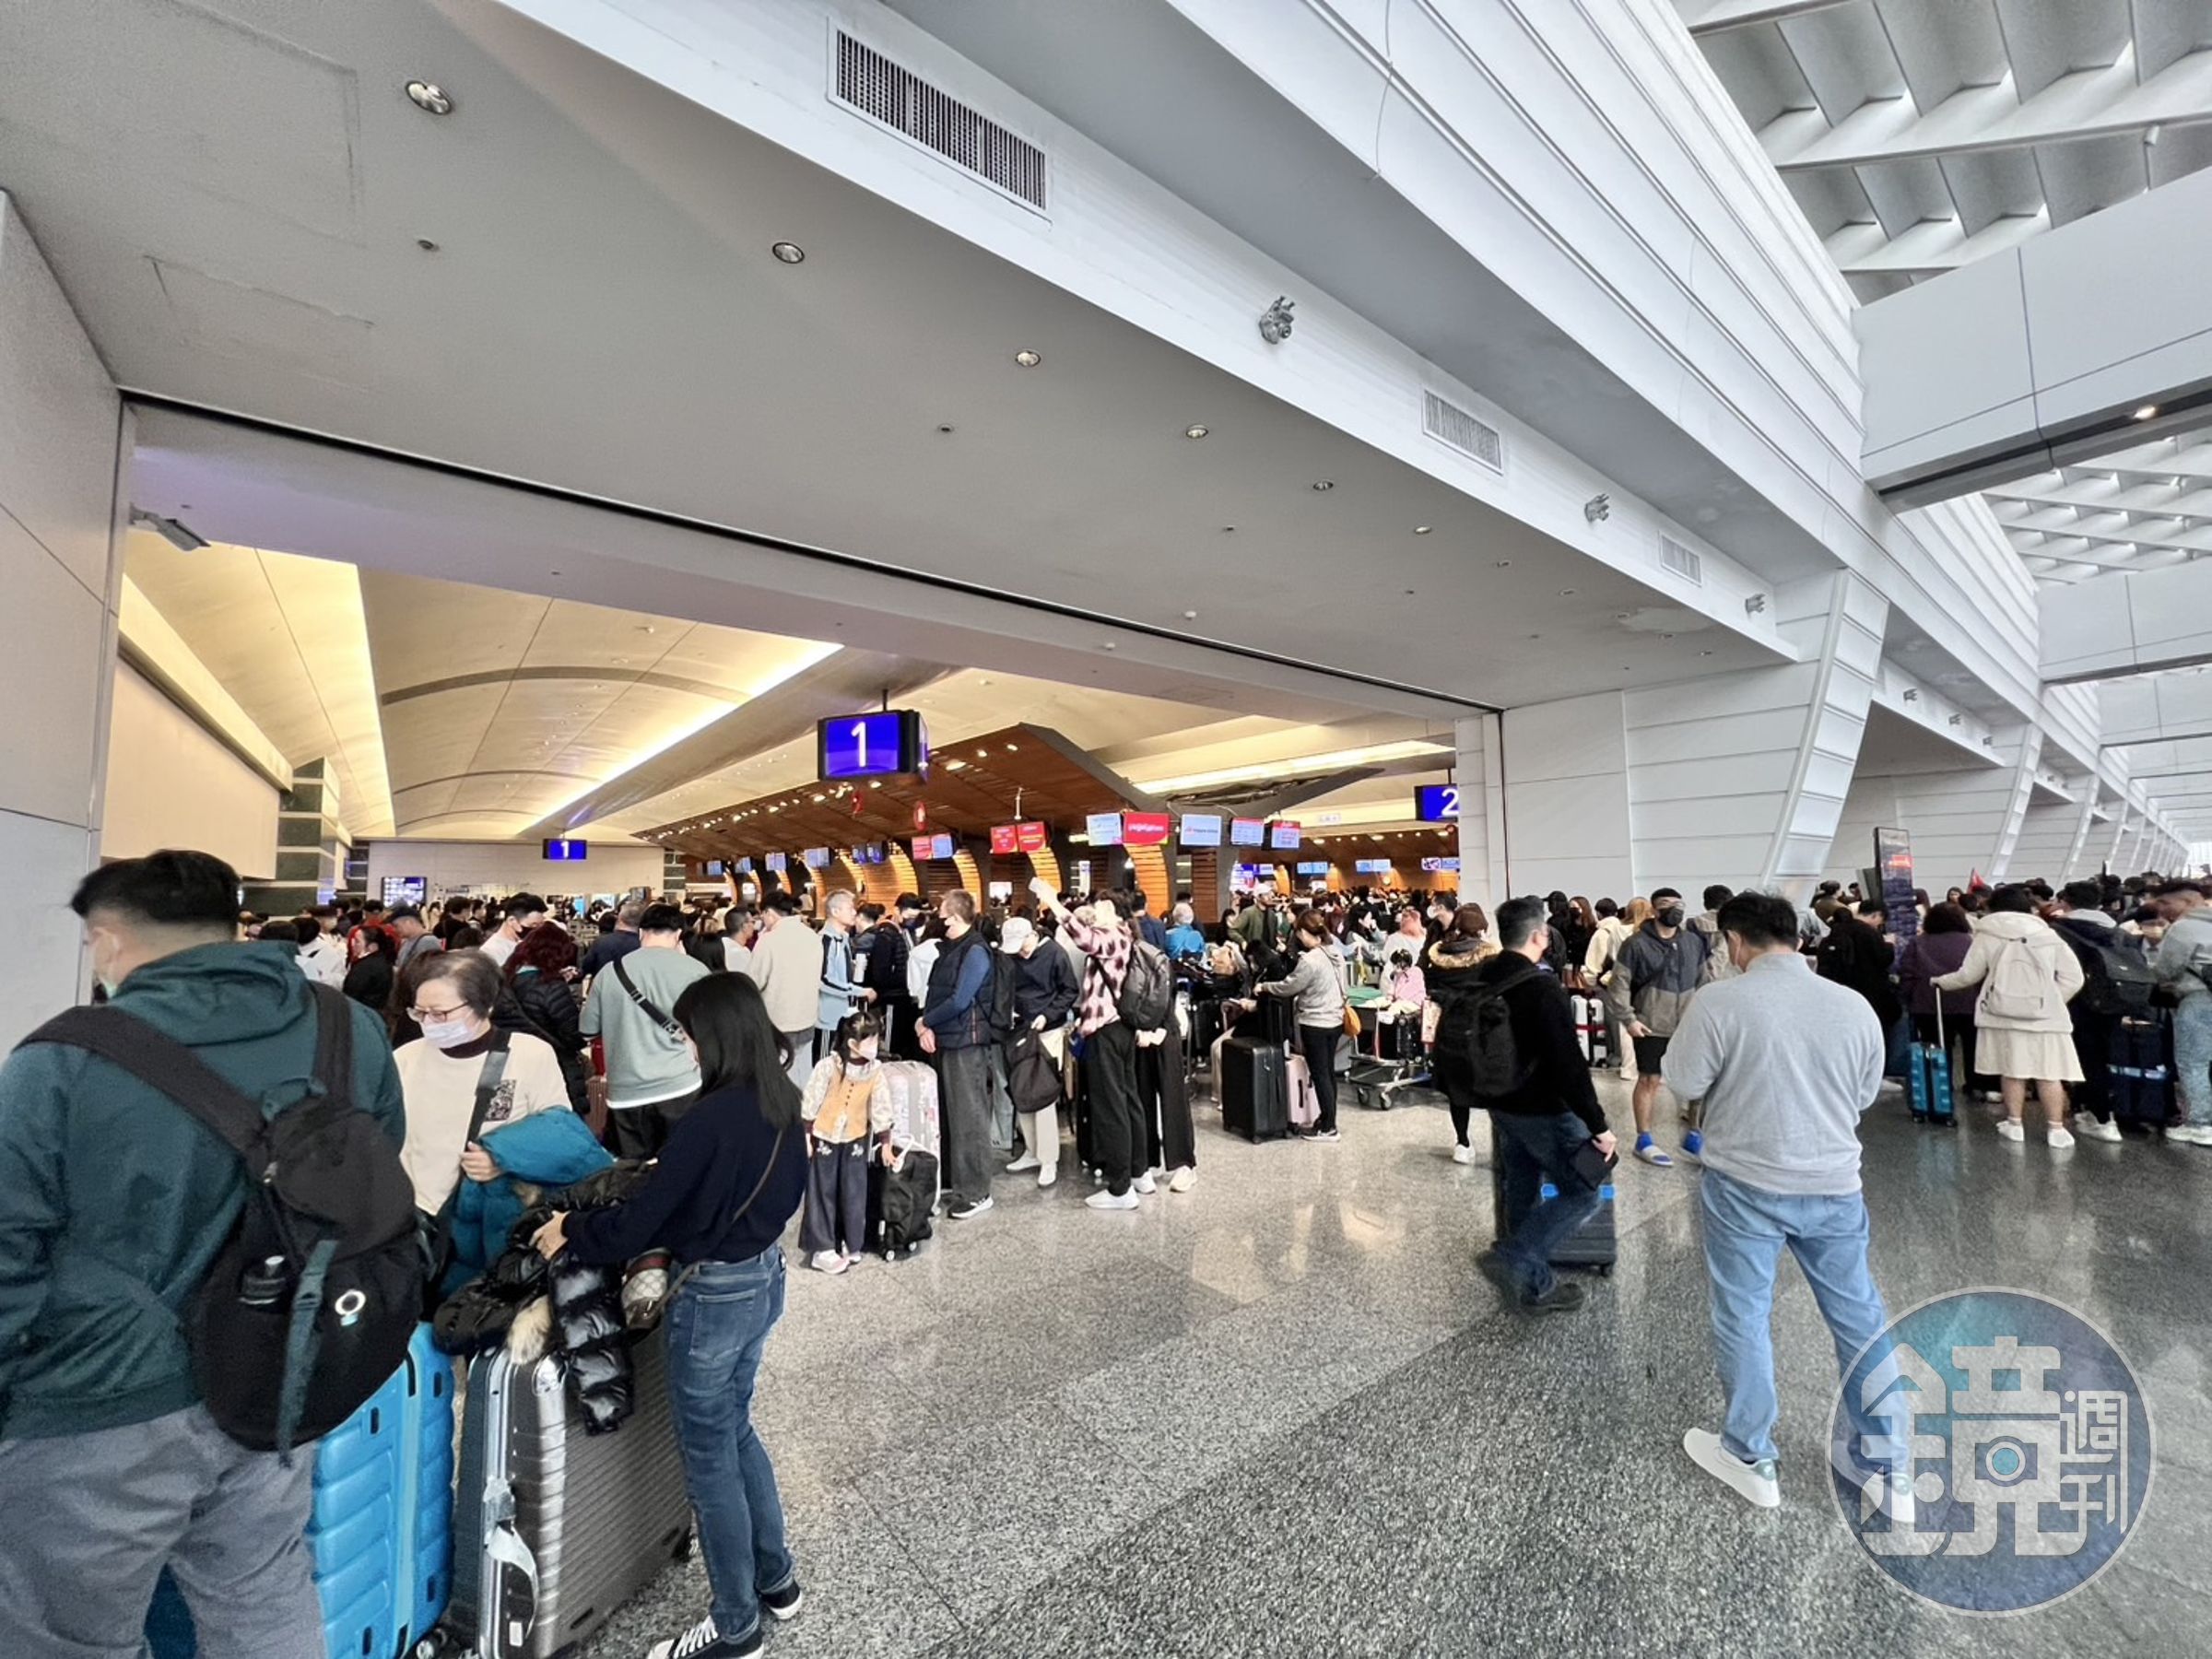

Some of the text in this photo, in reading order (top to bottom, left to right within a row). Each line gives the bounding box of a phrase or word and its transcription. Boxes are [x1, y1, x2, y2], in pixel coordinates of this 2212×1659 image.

[851, 721, 866, 768] 1
[1441, 788, 1459, 818] 2
[560, 841, 570, 858] 1
